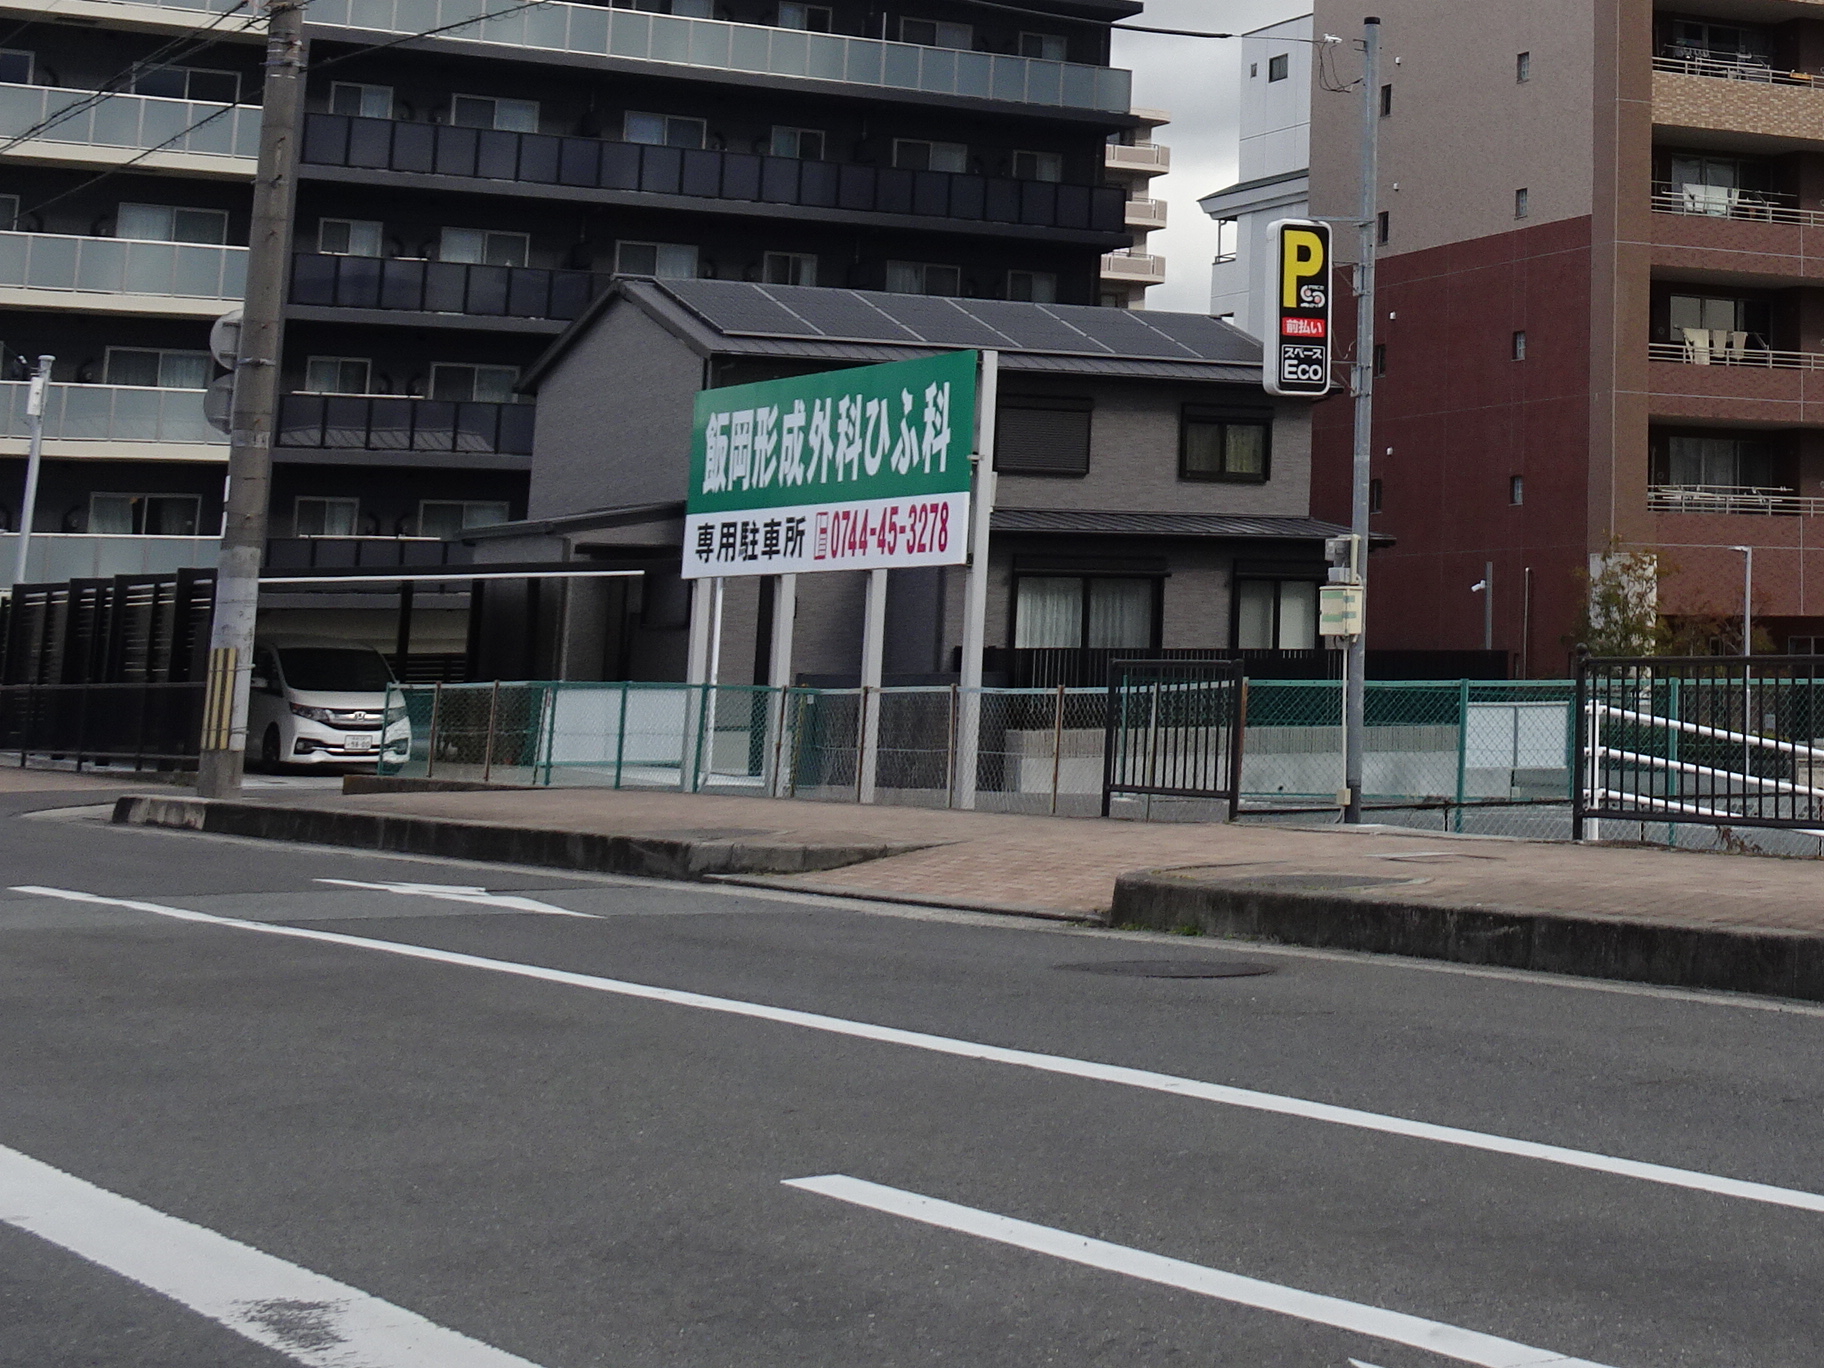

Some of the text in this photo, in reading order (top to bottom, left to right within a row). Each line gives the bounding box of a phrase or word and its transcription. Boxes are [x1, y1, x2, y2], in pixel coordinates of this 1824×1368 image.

[1284, 230, 1324, 308] P
[1284, 347, 1322, 359] スペース
[1286, 319, 1323, 334] 前払い
[702, 381, 951, 494] 飯岡形成外科ひふ科
[830, 501, 949, 559] 0744-45-3278
